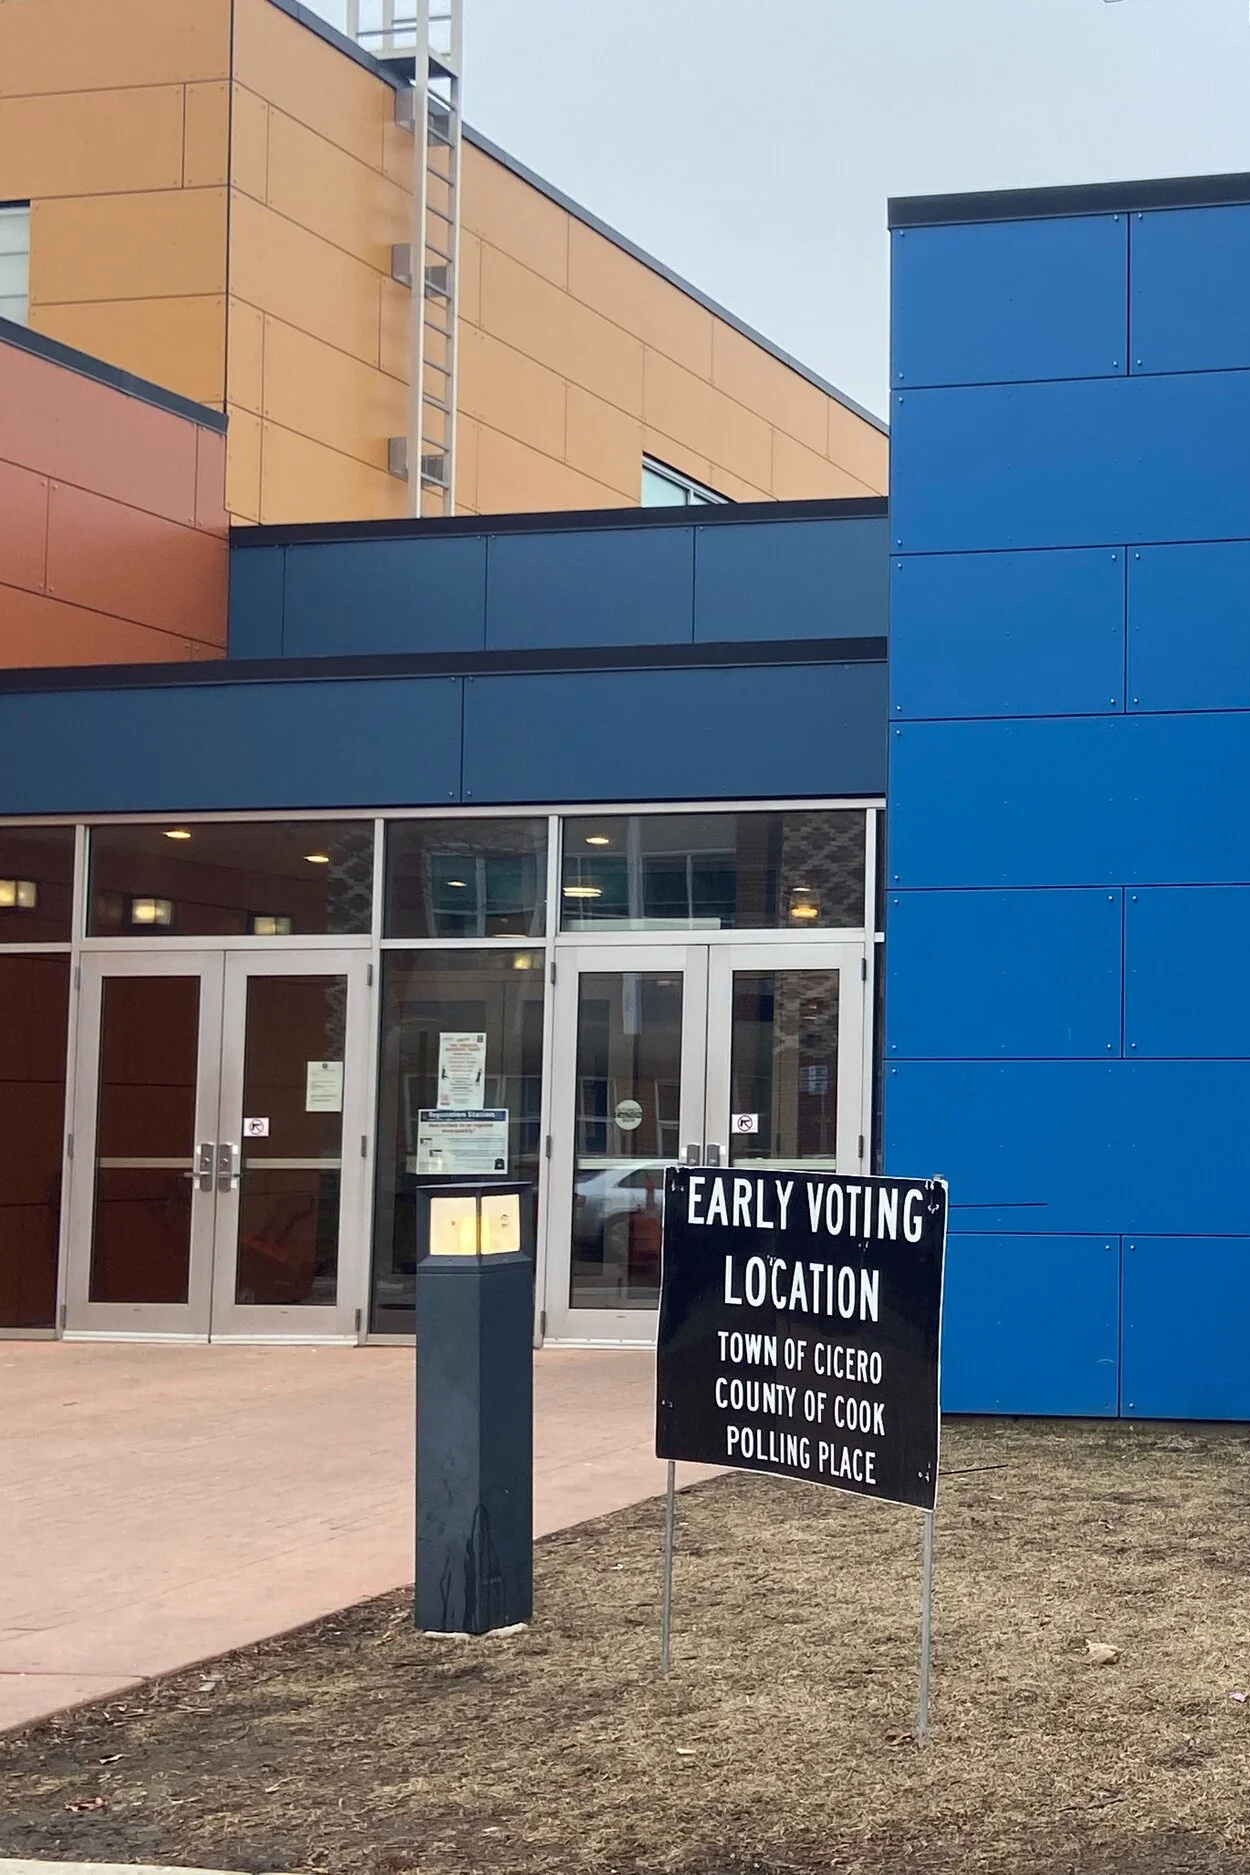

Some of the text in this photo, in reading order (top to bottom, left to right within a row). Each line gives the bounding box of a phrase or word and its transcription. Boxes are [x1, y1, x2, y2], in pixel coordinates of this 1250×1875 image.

[687, 1175, 925, 1243] EARLY VOTING
[724, 1254, 880, 1323] LOCATION
[717, 1330, 883, 1385] TOWN OF CICERO
[715, 1377, 886, 1436] COUNTY OF COOK
[727, 1425, 877, 1485] POLLING PLACE
